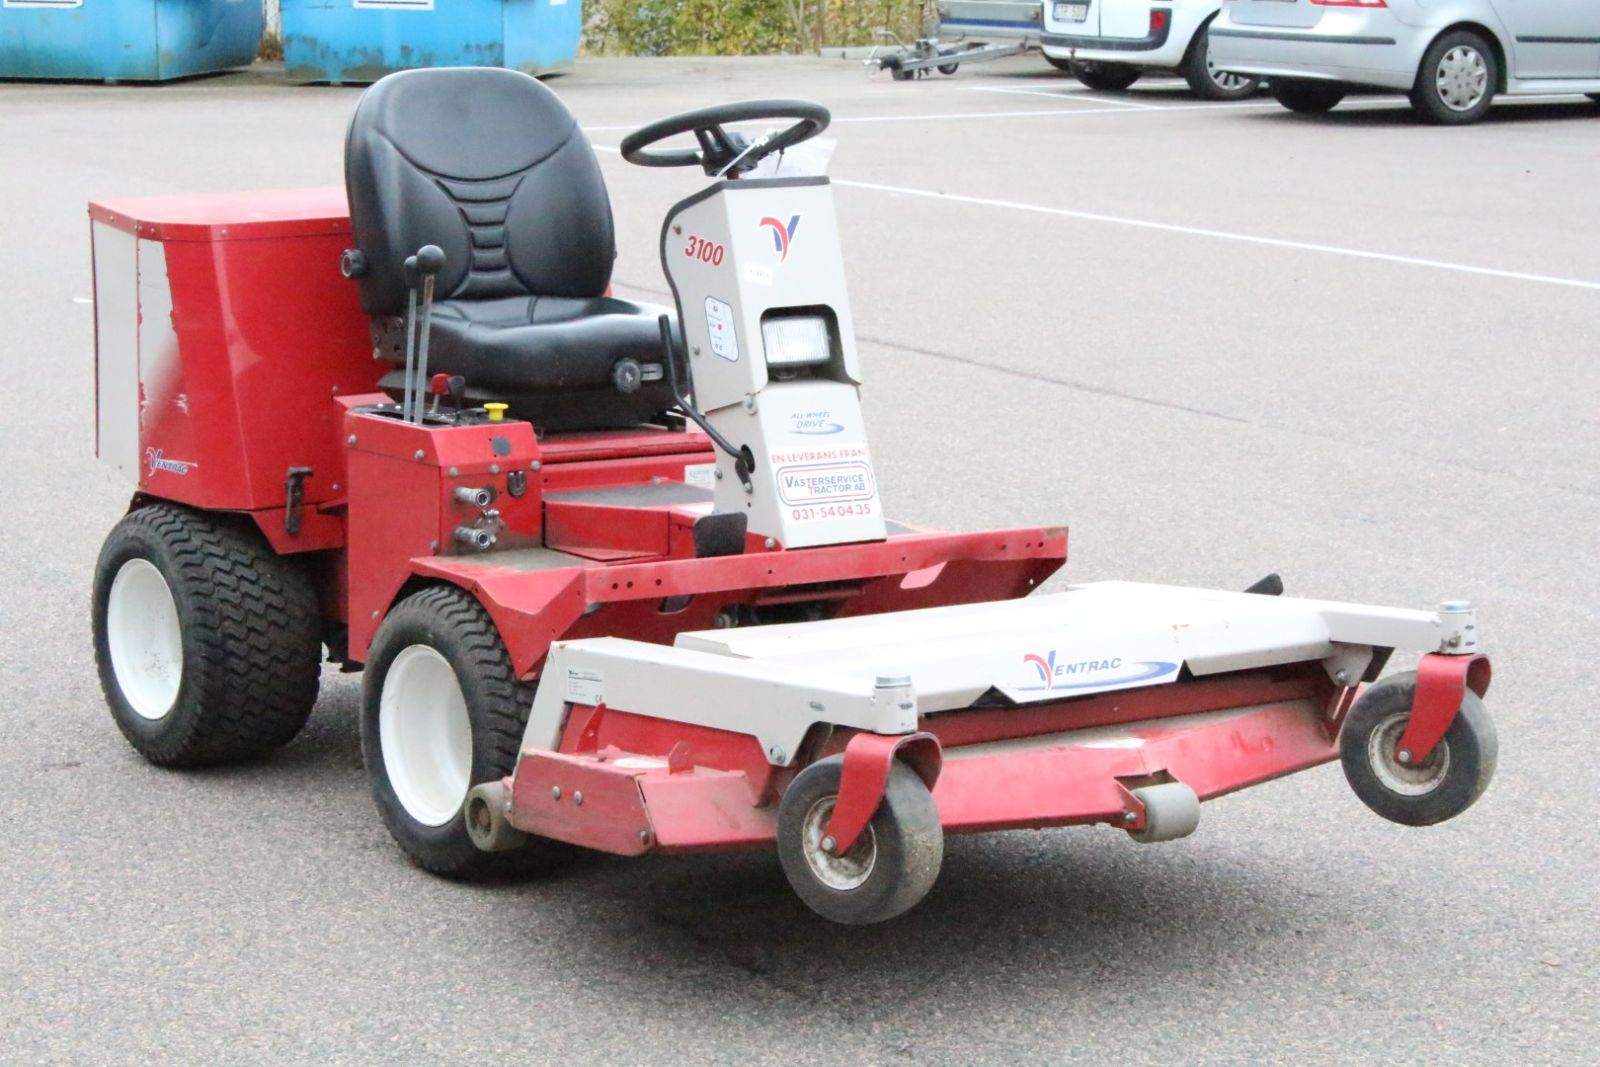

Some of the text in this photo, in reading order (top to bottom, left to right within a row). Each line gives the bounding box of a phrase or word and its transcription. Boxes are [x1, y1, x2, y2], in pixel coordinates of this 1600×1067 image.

[684, 235, 724, 266] 3100
[796, 419, 825, 429] DRIVE
[146, 446, 188, 477] VENTRAC
[771, 454, 785, 464] EN
[787, 450, 837, 463] LEVERANS
[807, 482, 866, 495] TRACTOR AB
[1023, 650, 1122, 690] VENTRAC
